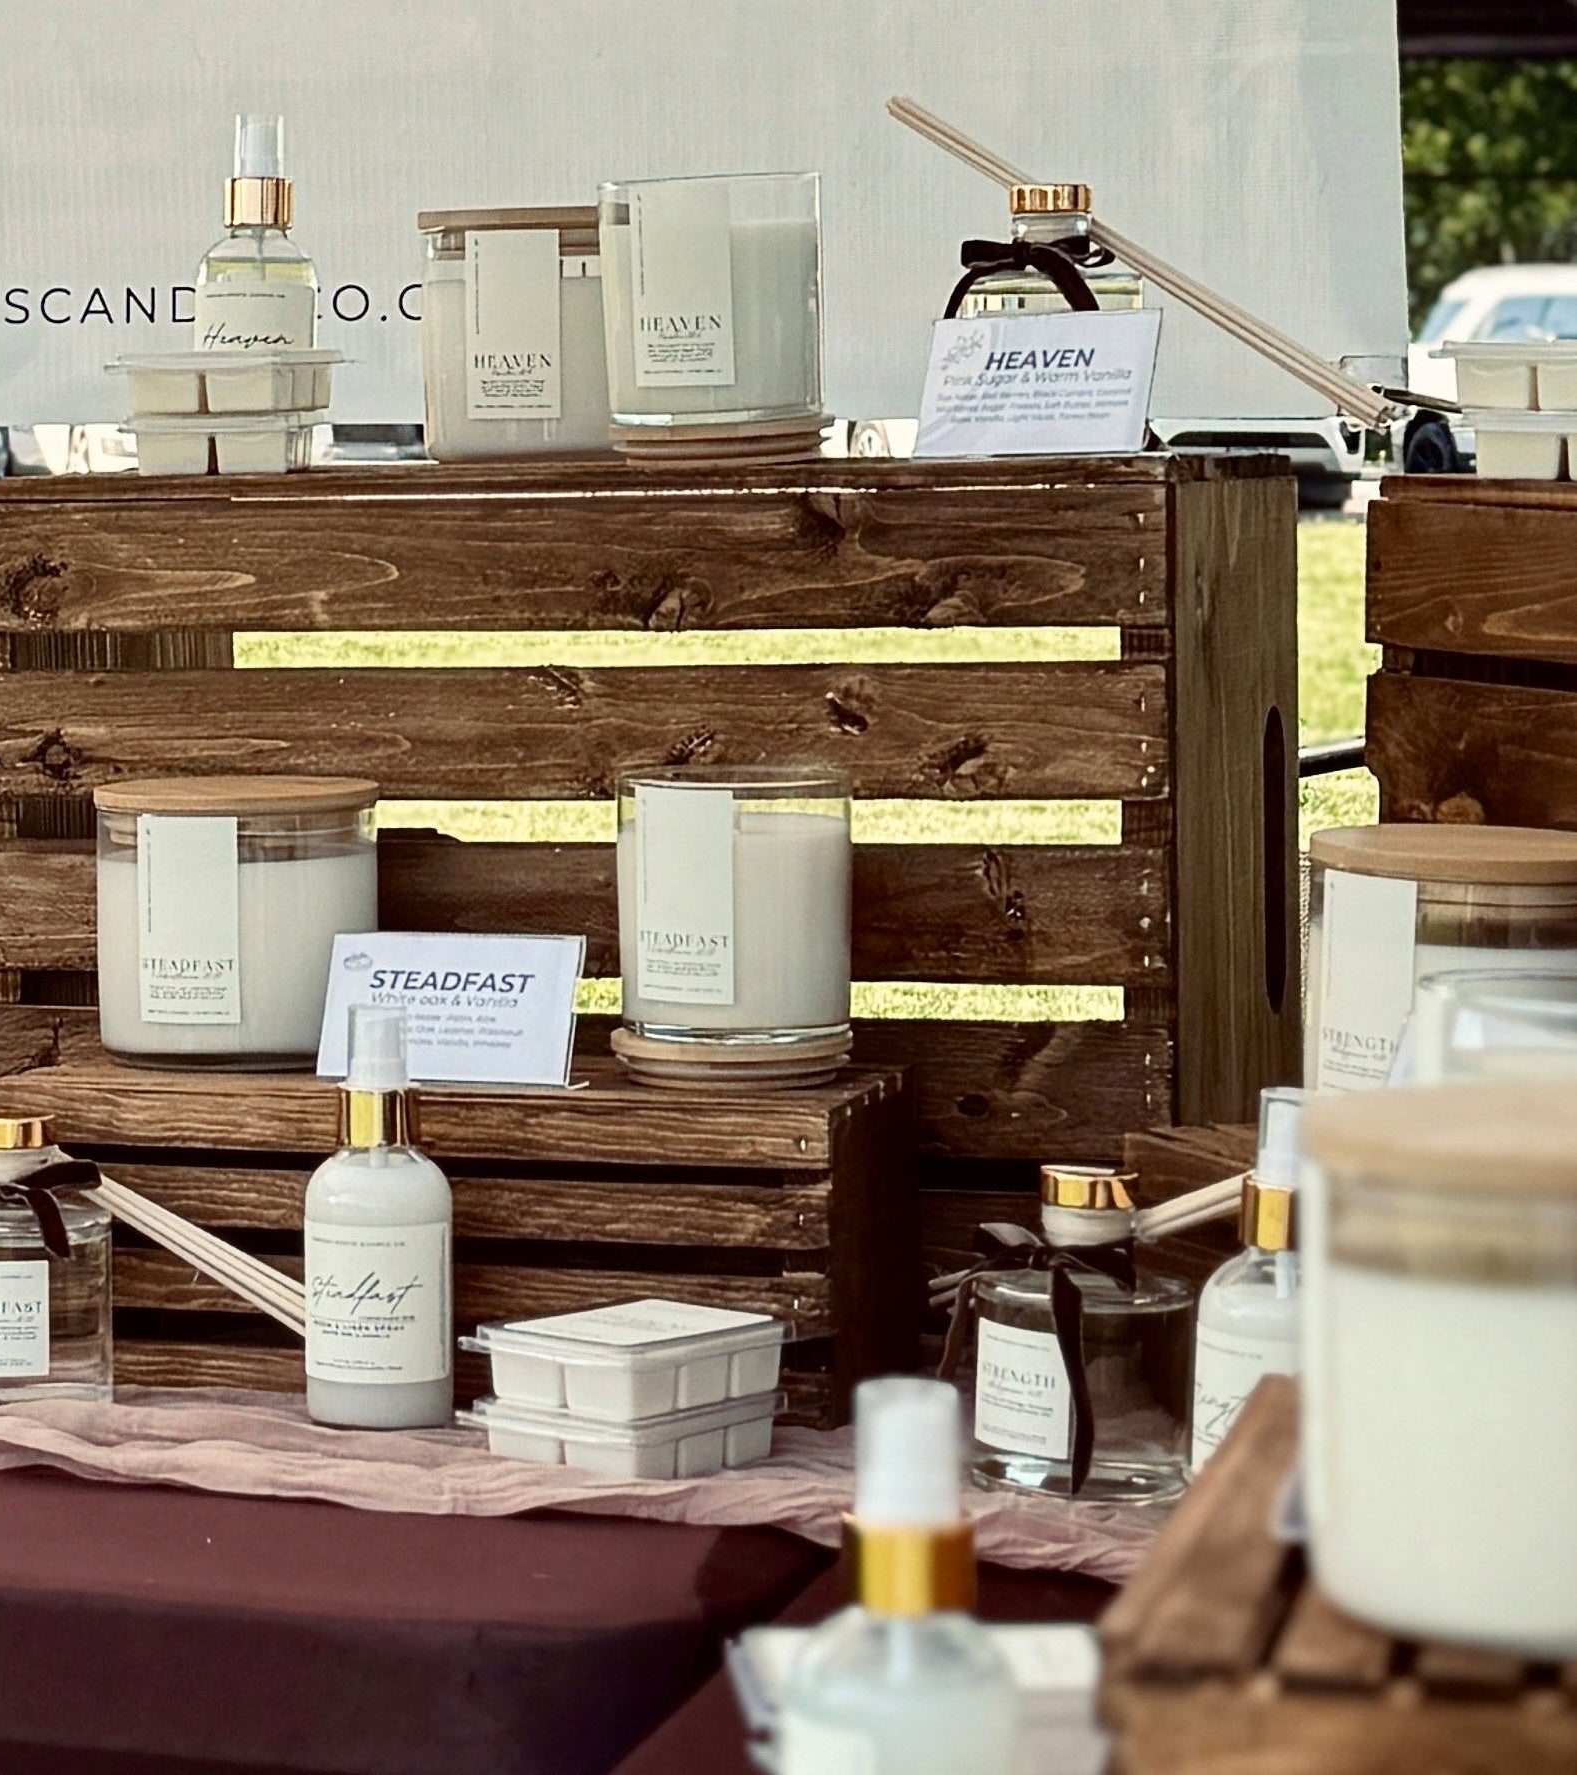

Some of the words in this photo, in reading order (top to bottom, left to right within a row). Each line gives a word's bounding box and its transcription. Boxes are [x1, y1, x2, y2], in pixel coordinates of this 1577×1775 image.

[640, 315, 721, 332] HEAVEN
[474, 353, 552, 369] HEAVEN
[984, 348, 1094, 371] HEAVEN
[976, 372, 1017, 388] Sugar
[1022, 372, 1031, 385] &
[1034, 371, 1079, 384] Warm
[1084, 368, 1132, 382] Vanilla
[369, 969, 535, 994] STEADFAST
